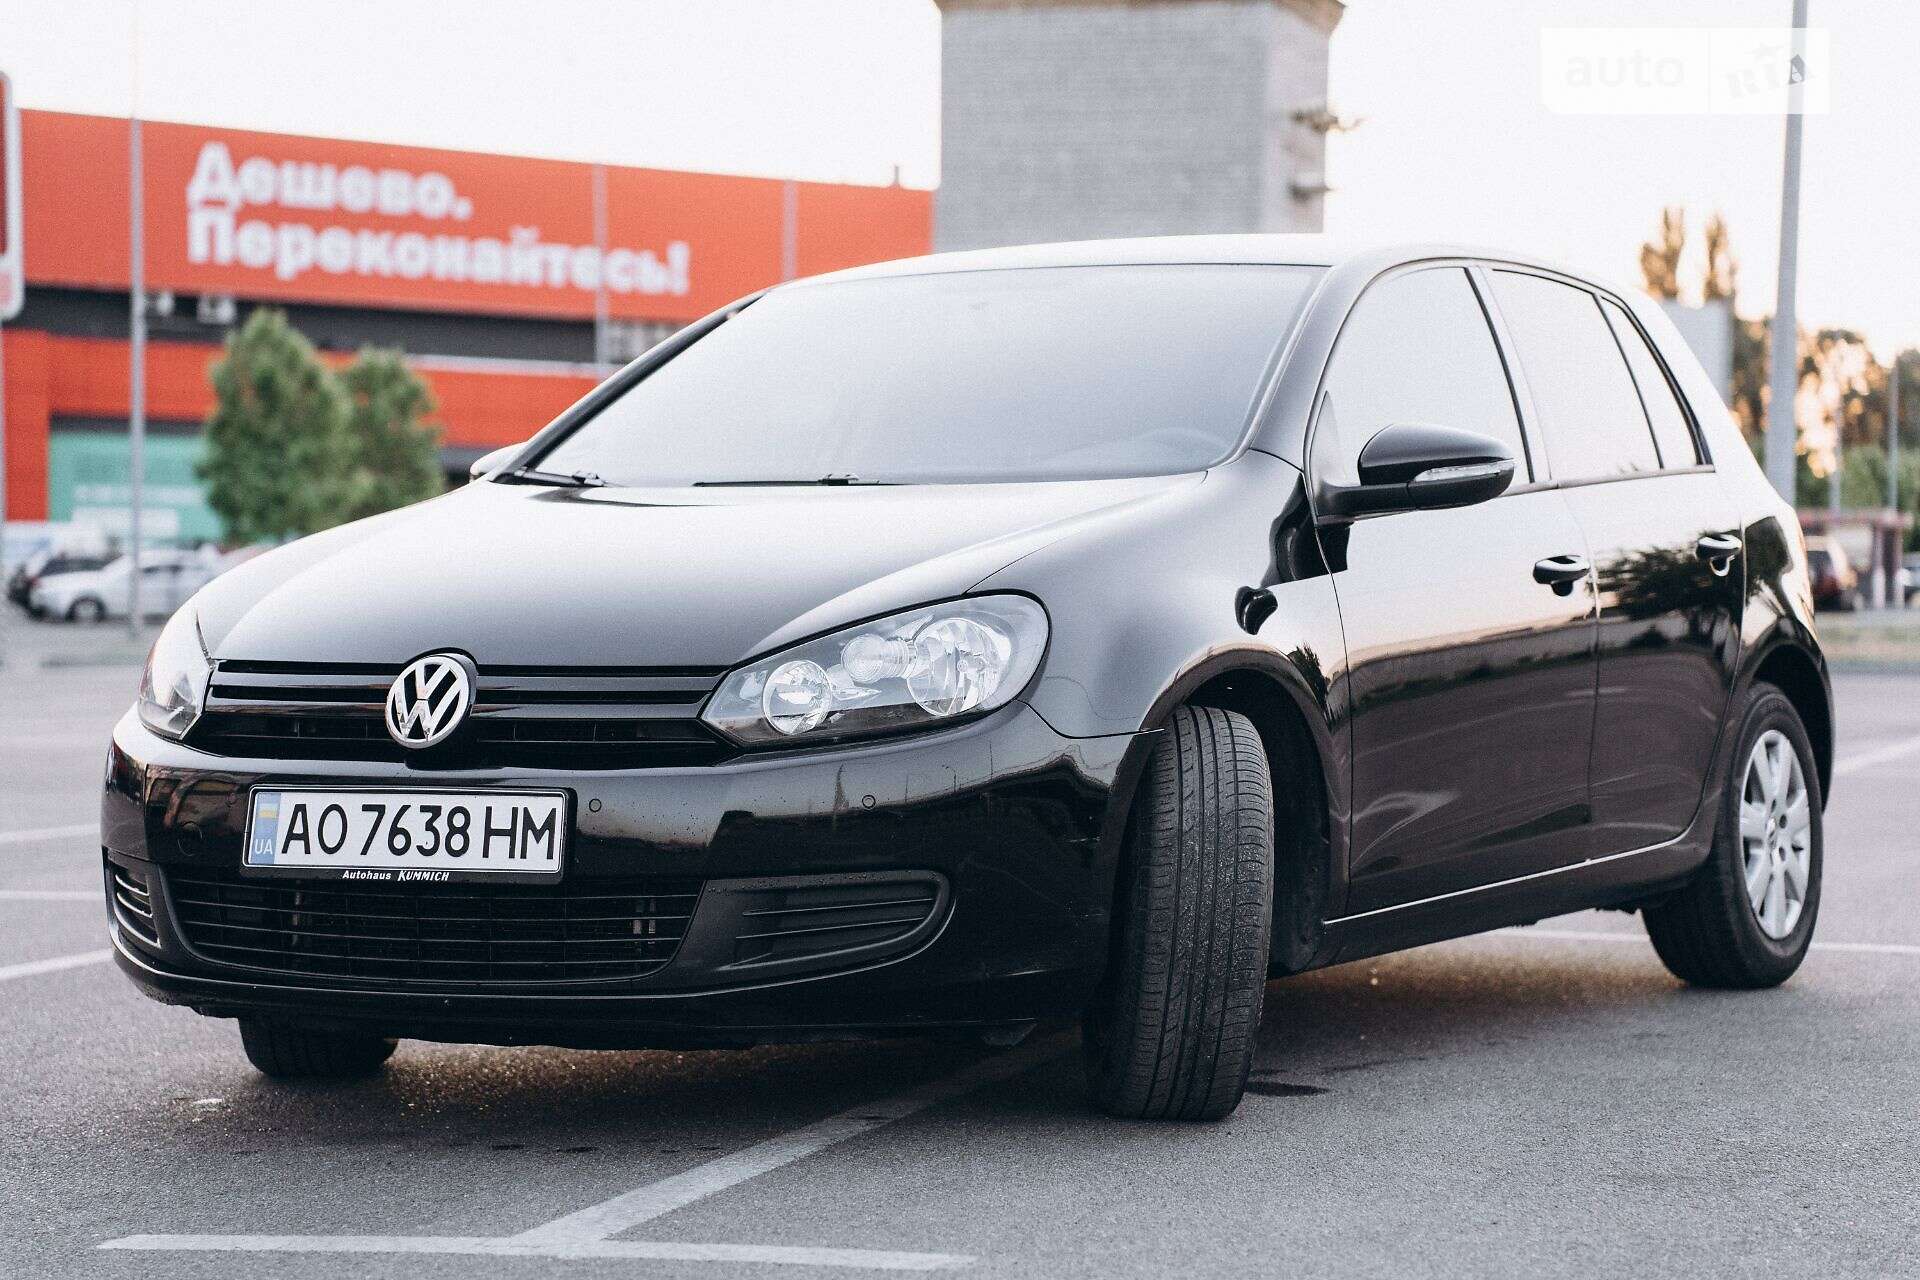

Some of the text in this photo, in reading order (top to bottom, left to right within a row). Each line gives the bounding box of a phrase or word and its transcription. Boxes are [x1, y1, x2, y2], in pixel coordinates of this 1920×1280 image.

[186, 141, 473, 220] Дешево.
[186, 212, 690, 296] Переконайтесь!
[254, 838, 273, 855] UA
[281, 803, 556, 860] AO 7638 HM
[342, 870, 391, 880] Autohaus
